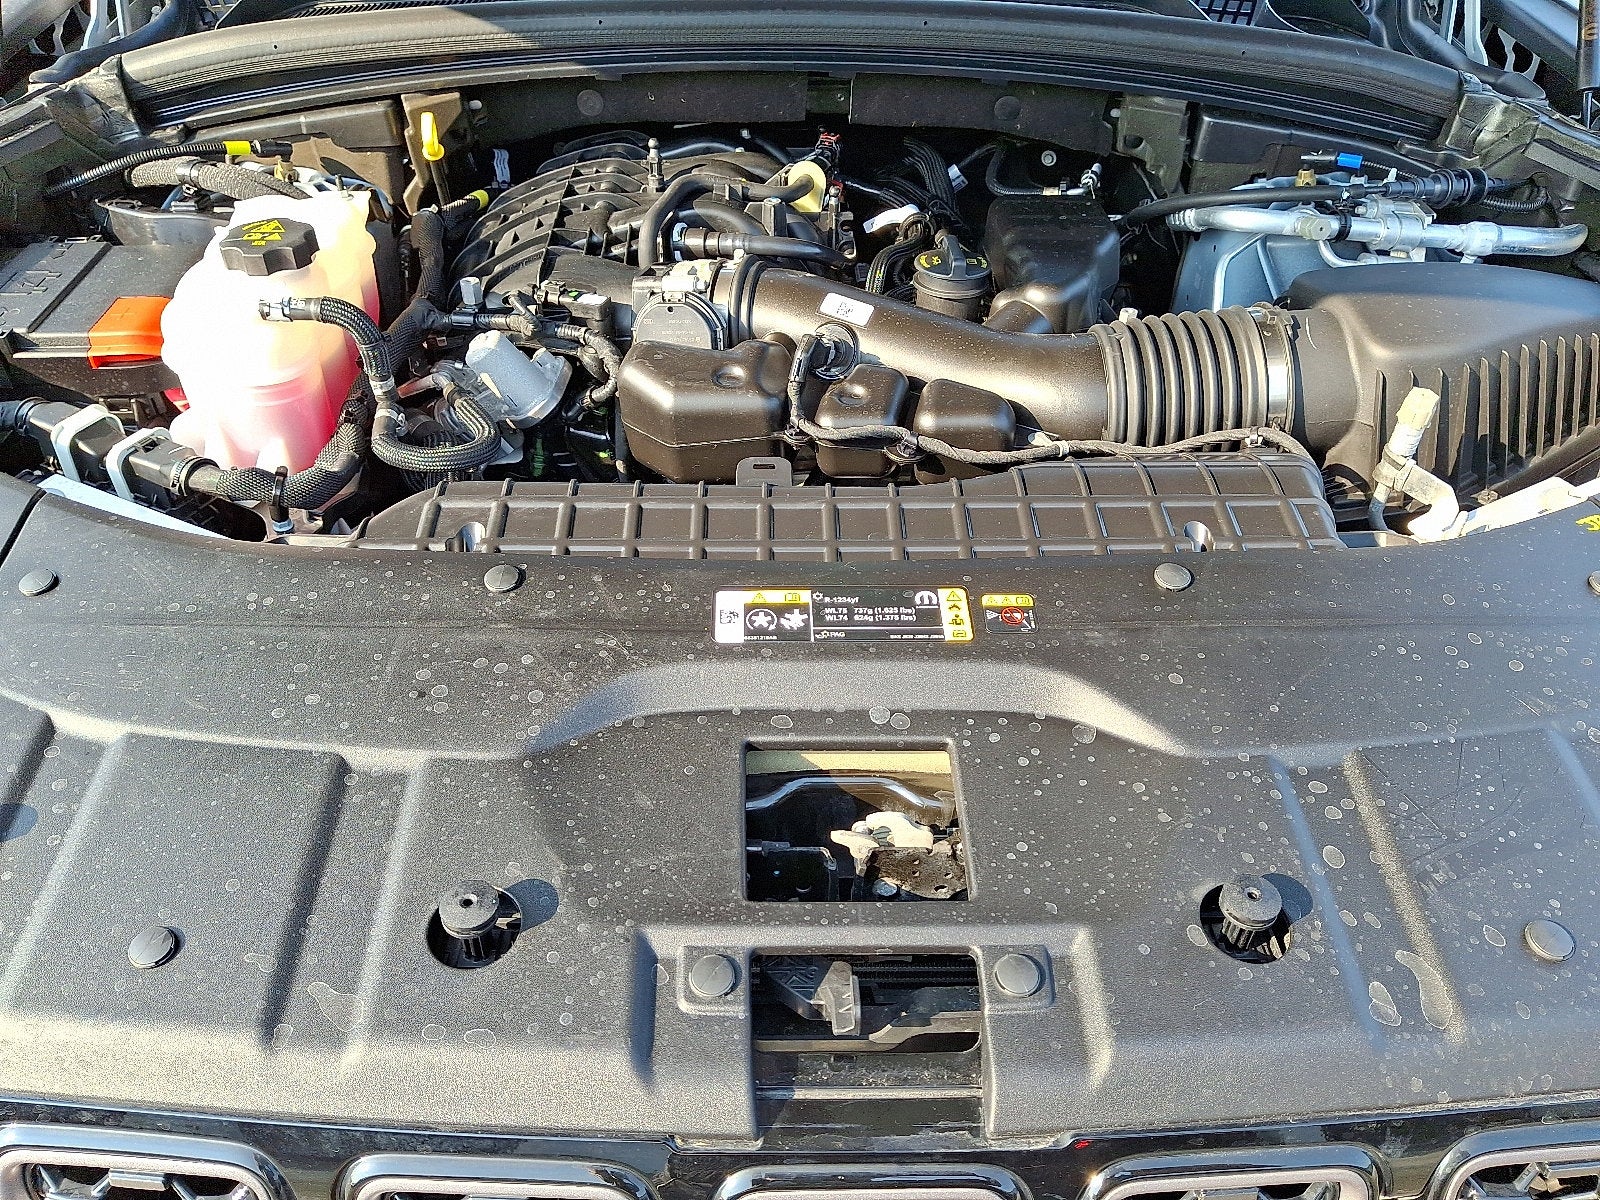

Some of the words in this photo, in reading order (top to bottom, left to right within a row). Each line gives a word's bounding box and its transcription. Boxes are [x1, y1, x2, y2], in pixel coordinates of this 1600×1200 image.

[825, 596, 859, 604] R-1234yf
[853, 607, 874, 615] 737g
[900, 607, 916, 615] lbs)
[825, 614, 849, 622] WL74
